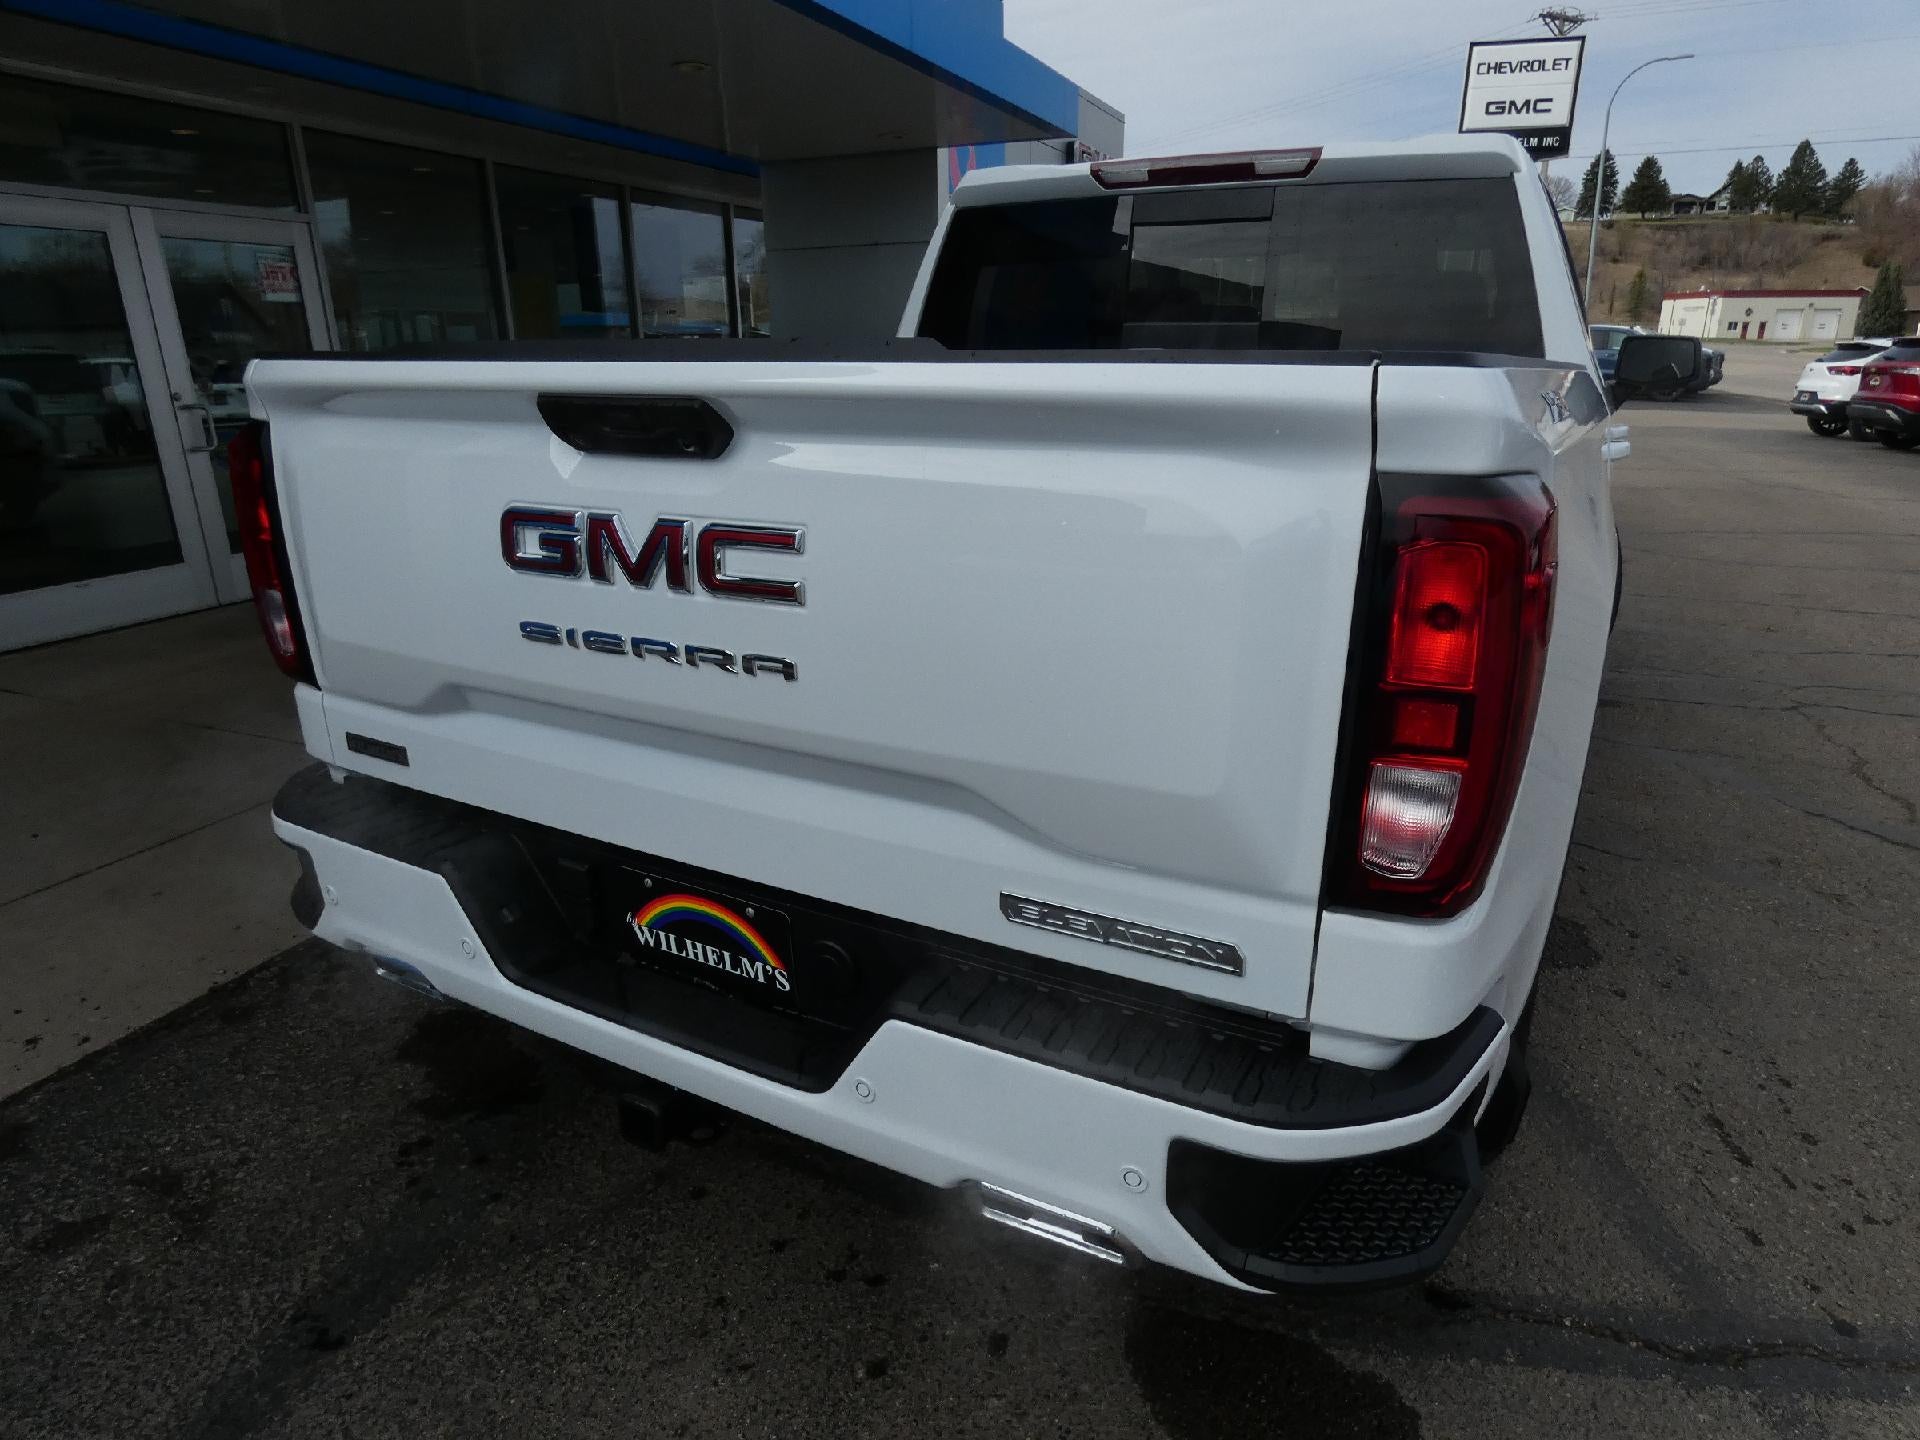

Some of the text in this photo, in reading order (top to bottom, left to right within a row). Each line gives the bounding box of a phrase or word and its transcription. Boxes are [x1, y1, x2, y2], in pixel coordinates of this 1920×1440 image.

[1476, 57, 1573, 75] CHEVROLET
[1485, 98, 1554, 116] GMC
[1542, 136, 1560, 147] INC
[500, 501, 808, 608] GMC
[519, 620, 799, 682] SIERRA
[633, 925, 791, 992] WILHELM'S
[1014, 903, 1227, 964] ELEVATION
